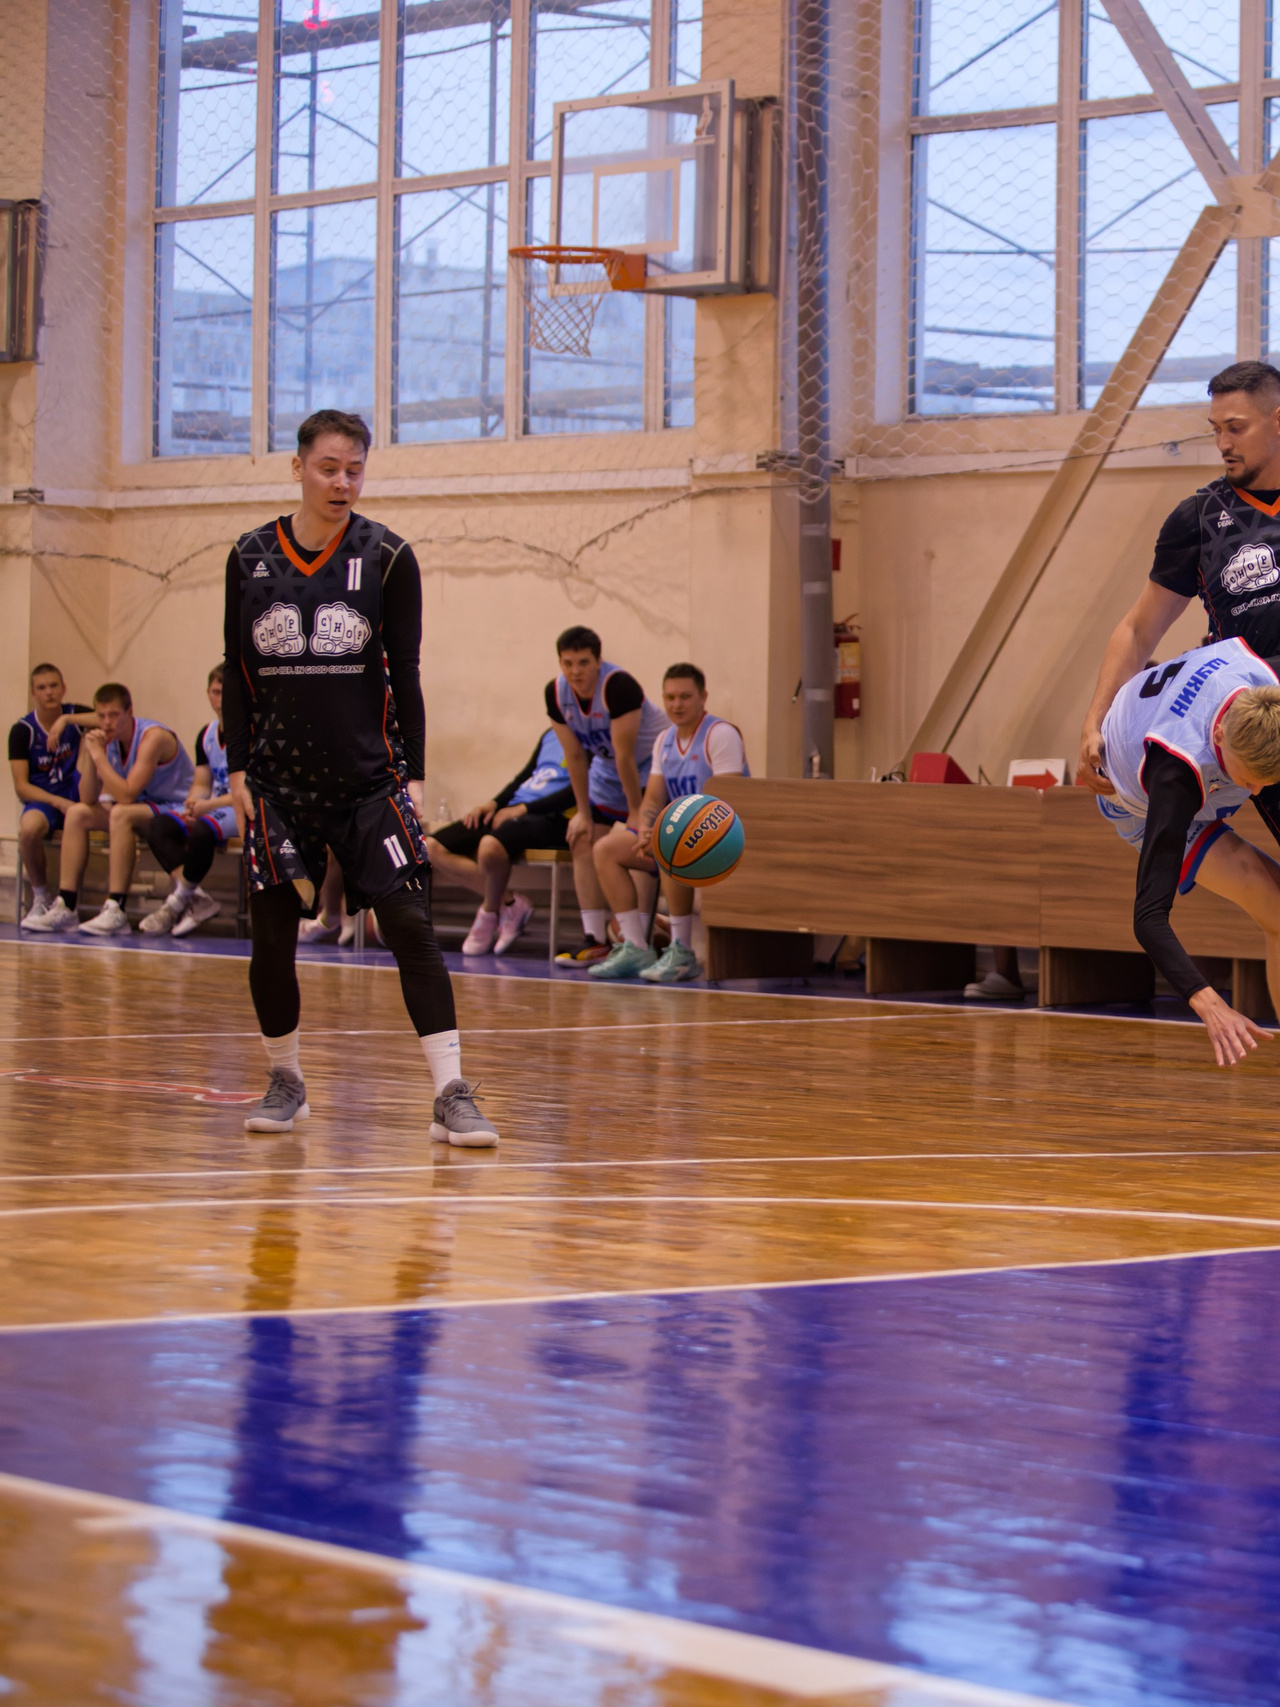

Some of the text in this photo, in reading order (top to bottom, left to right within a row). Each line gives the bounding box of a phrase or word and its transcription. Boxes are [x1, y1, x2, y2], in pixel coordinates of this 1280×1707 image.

[1217, 519, 1234, 528] PEAK
[253, 570, 270, 578] PEAK
[348, 558, 362, 591] 11
[259, 616, 363, 643] CHOP CHOP
[304, 665, 328, 675] GOOD
[328, 664, 366, 674] COMPANY
[1139, 660, 1187, 698] 5
[1170, 658, 1229, 718] ЩУКИН
[684, 805, 731, 849] Wilson
[383, 835, 408, 869] 11
